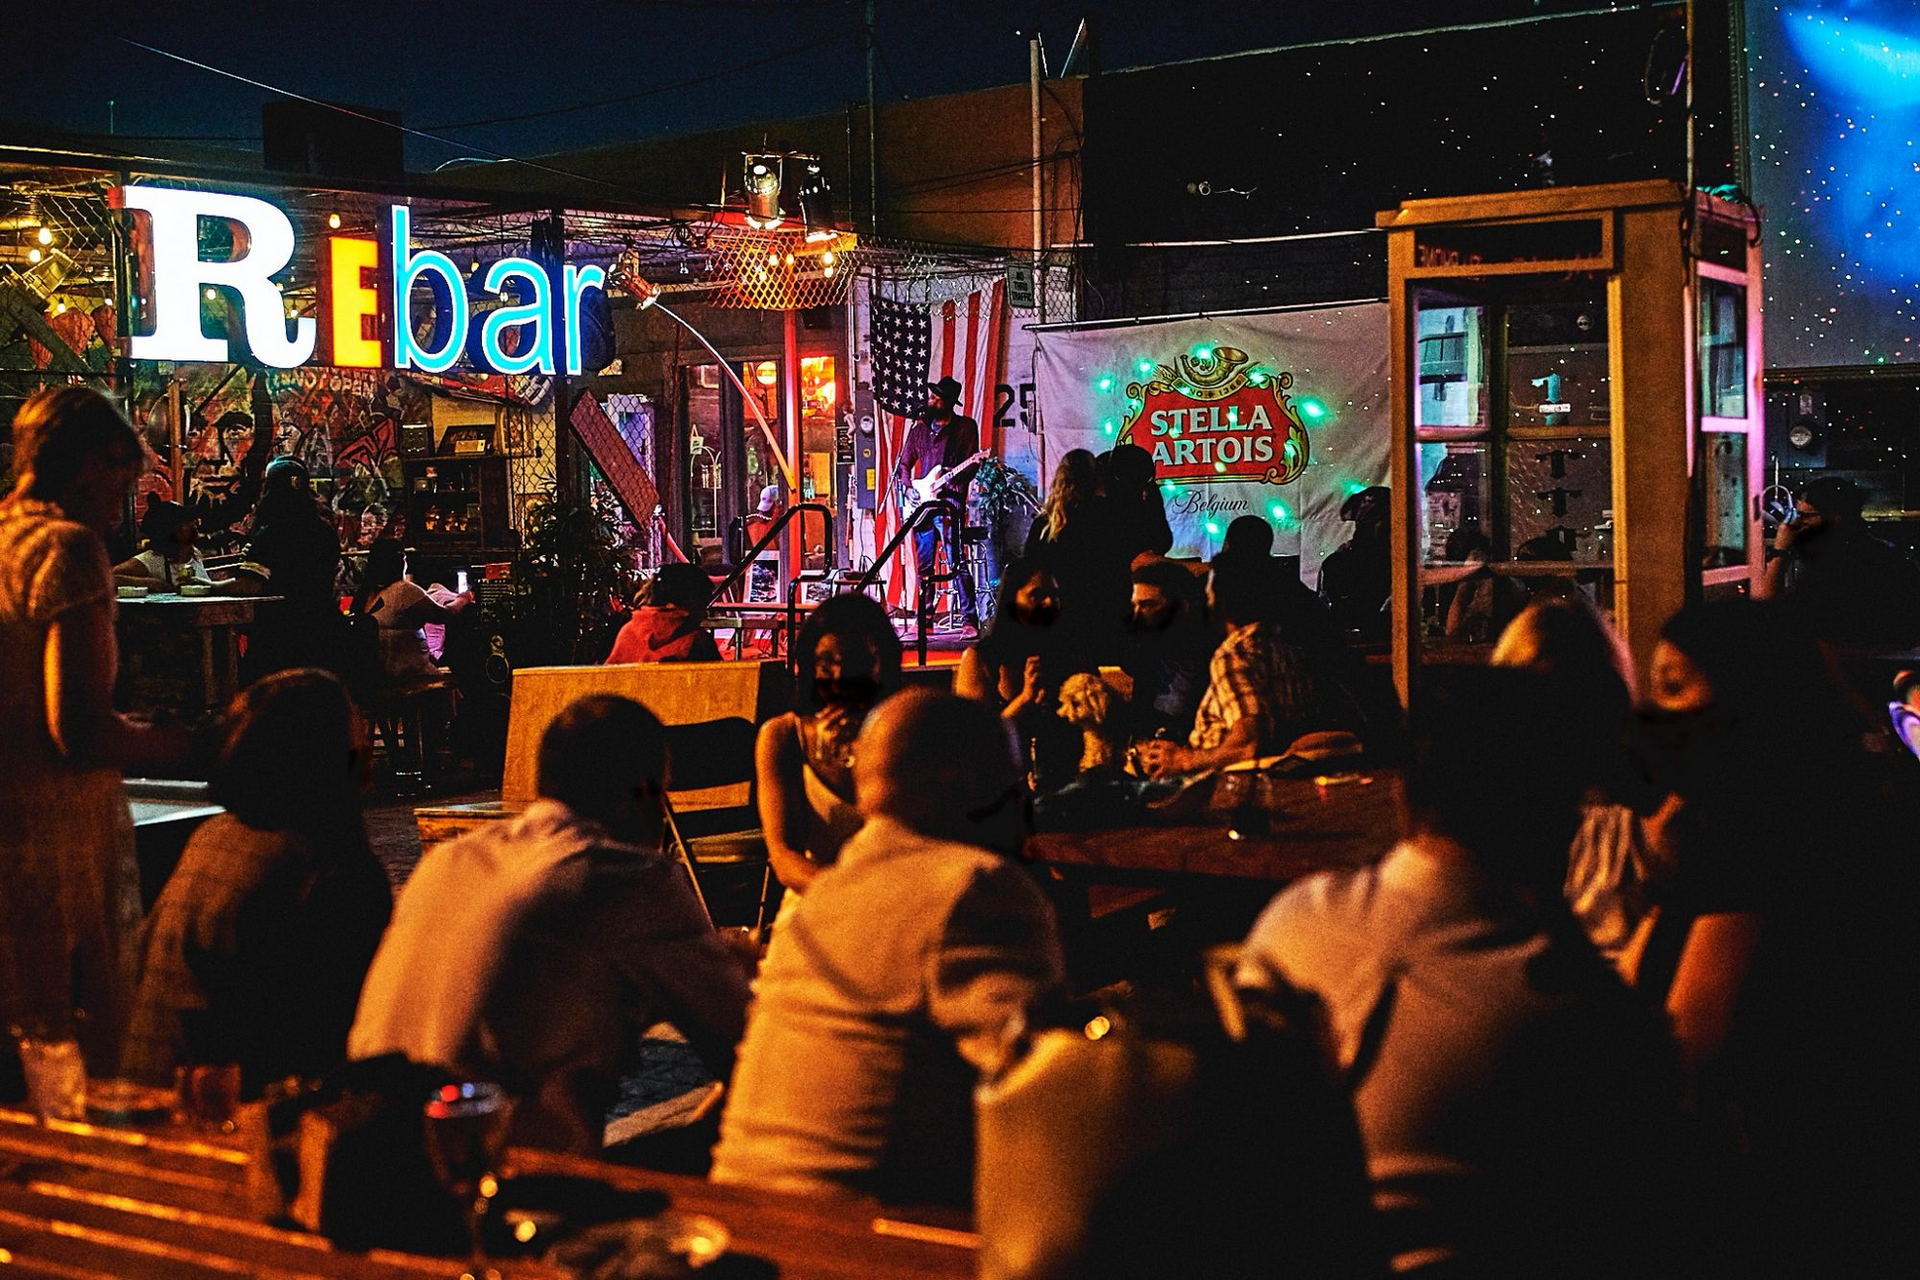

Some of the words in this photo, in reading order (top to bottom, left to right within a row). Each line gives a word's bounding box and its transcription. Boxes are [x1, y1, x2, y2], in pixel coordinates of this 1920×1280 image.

[1016, 271, 1025, 281] NO
[1012, 291, 1032, 302] TRAFFIC
[1150, 405, 1273, 436] STELLA
[1152, 436, 1274, 466] ARTOIS
[1171, 490, 1249, 519] Belgium
